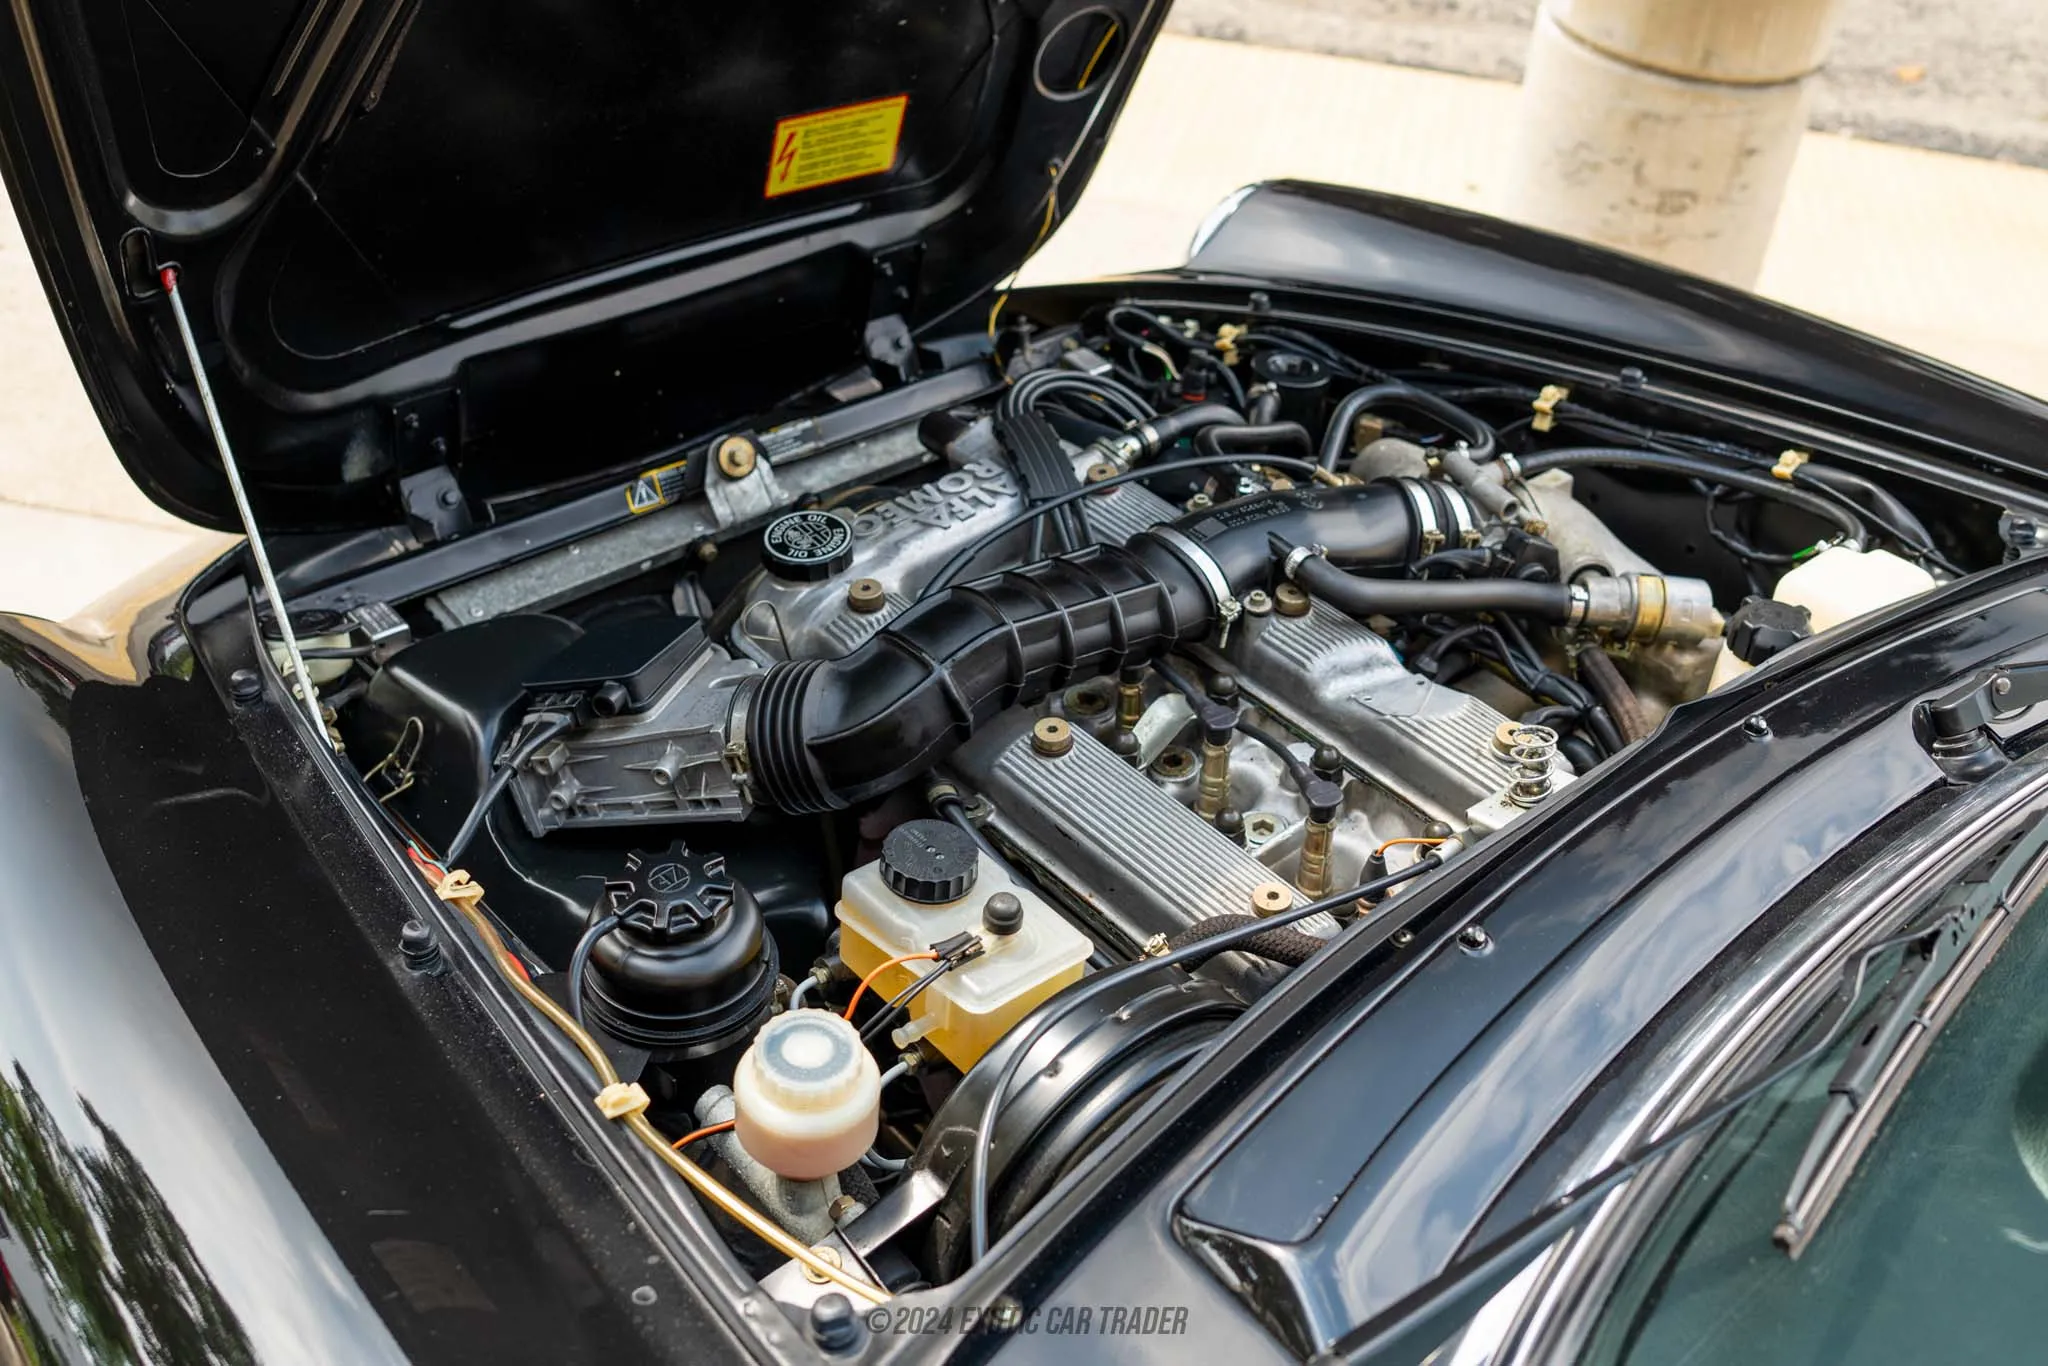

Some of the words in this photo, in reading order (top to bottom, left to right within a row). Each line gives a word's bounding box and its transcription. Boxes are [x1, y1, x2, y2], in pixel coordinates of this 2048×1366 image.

[852, 458, 1005, 538] ROMEO
[912, 472, 1018, 530] ALFA
[771, 515, 802, 544] ENGINE
[807, 514, 829, 524] OIL
[813, 528, 845, 556] ENGINE
[787, 548, 808, 558] OIL
